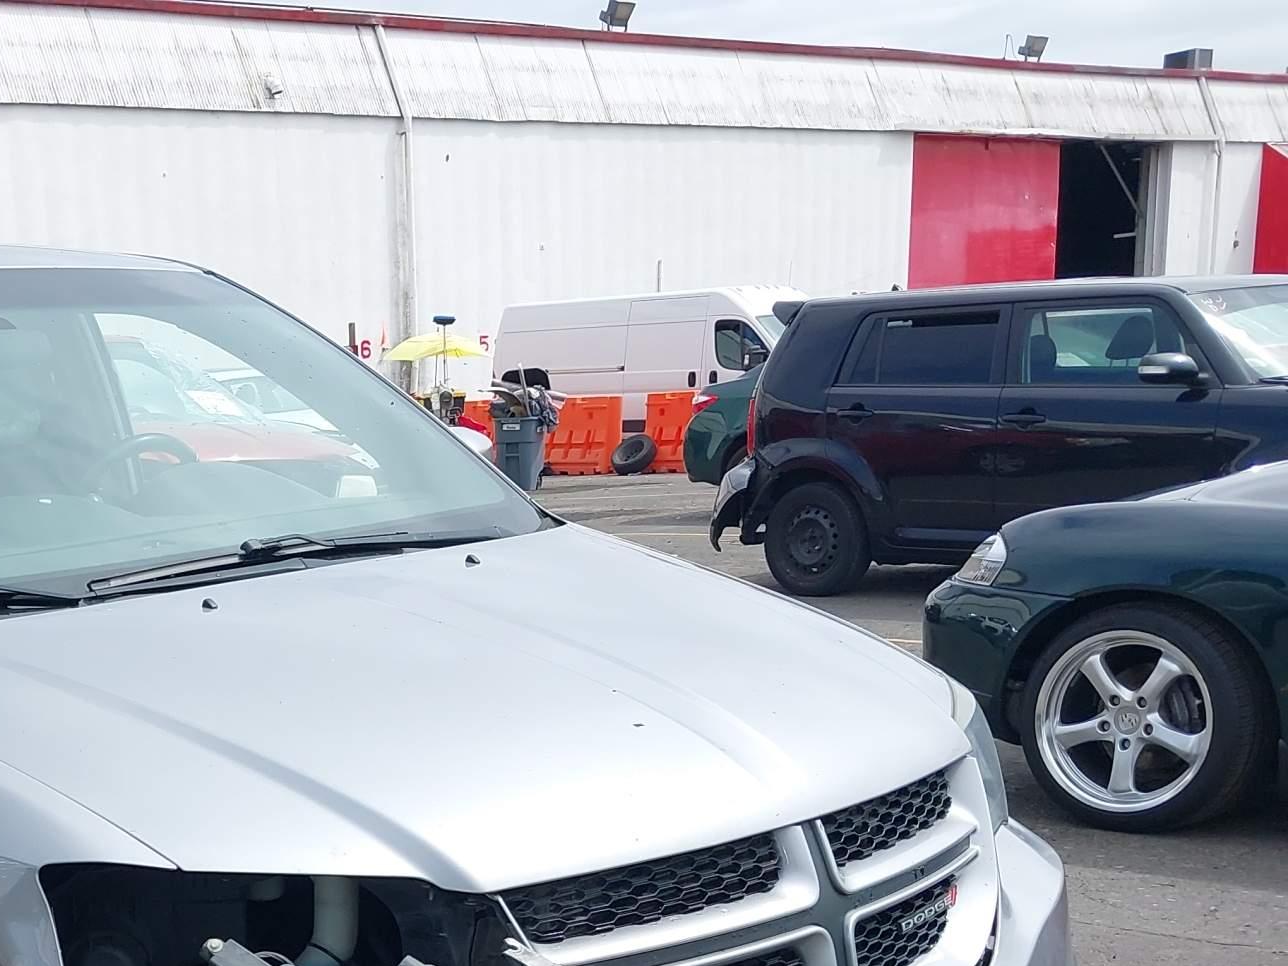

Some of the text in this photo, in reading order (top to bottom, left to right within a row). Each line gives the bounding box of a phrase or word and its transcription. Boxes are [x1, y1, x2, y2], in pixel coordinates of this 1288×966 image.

[360, 340, 372, 359] 6
[479, 335, 489, 352] 5
[901, 895, 953, 932] DODGE
